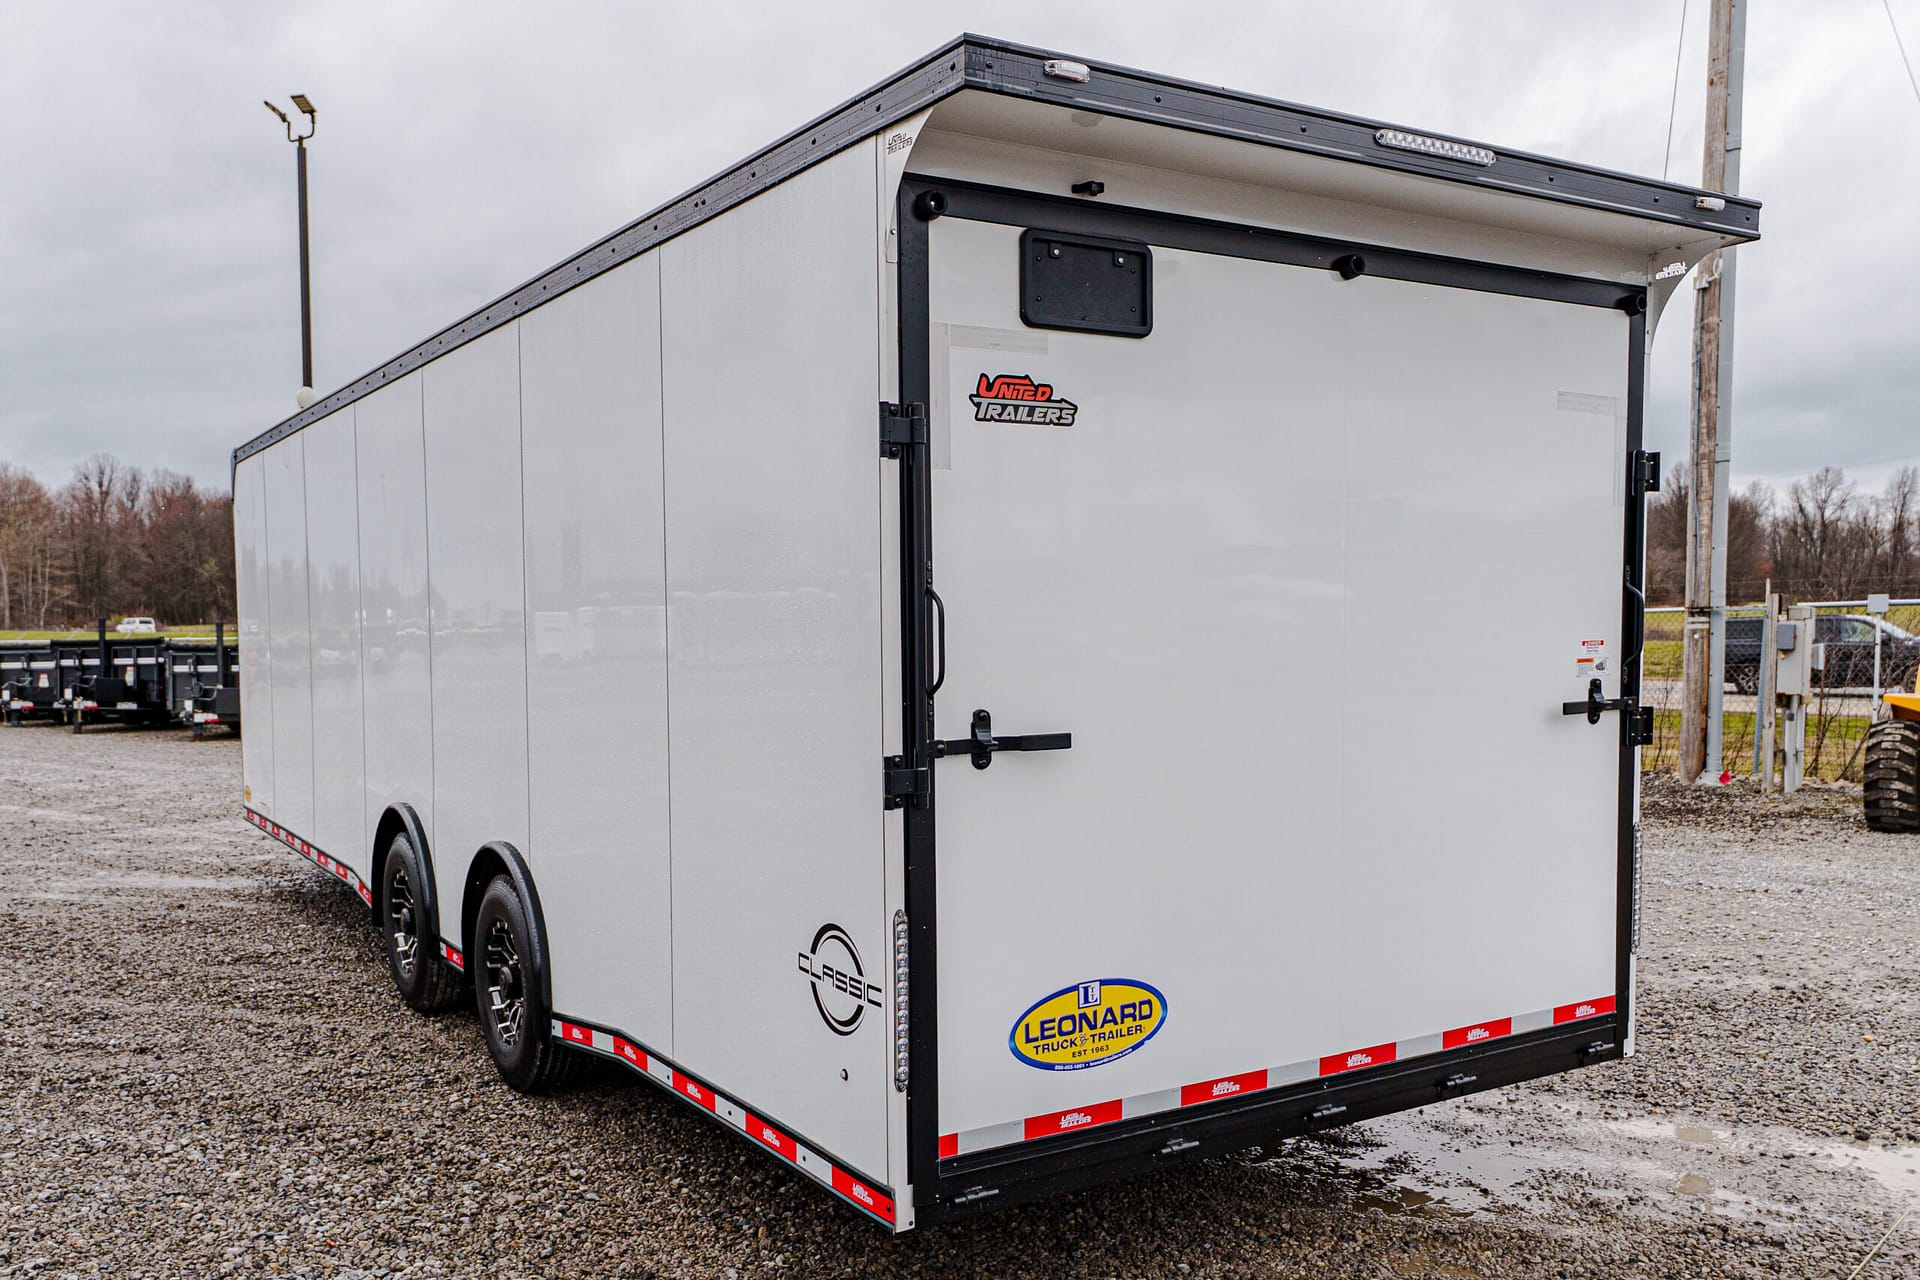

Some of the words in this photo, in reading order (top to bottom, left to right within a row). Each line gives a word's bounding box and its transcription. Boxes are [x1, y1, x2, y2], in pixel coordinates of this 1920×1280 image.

[969, 397, 1077, 424] TRAILERS
[798, 952, 883, 1008] CLASSIC
[1024, 998, 1153, 1044] LEONARD
[1033, 1037, 1078, 1055] TRUCK
[1090, 1024, 1143, 1044] TRAILER
[1071, 1049, 1087, 1058] EST
[1091, 1044, 1110, 1054] 1963
